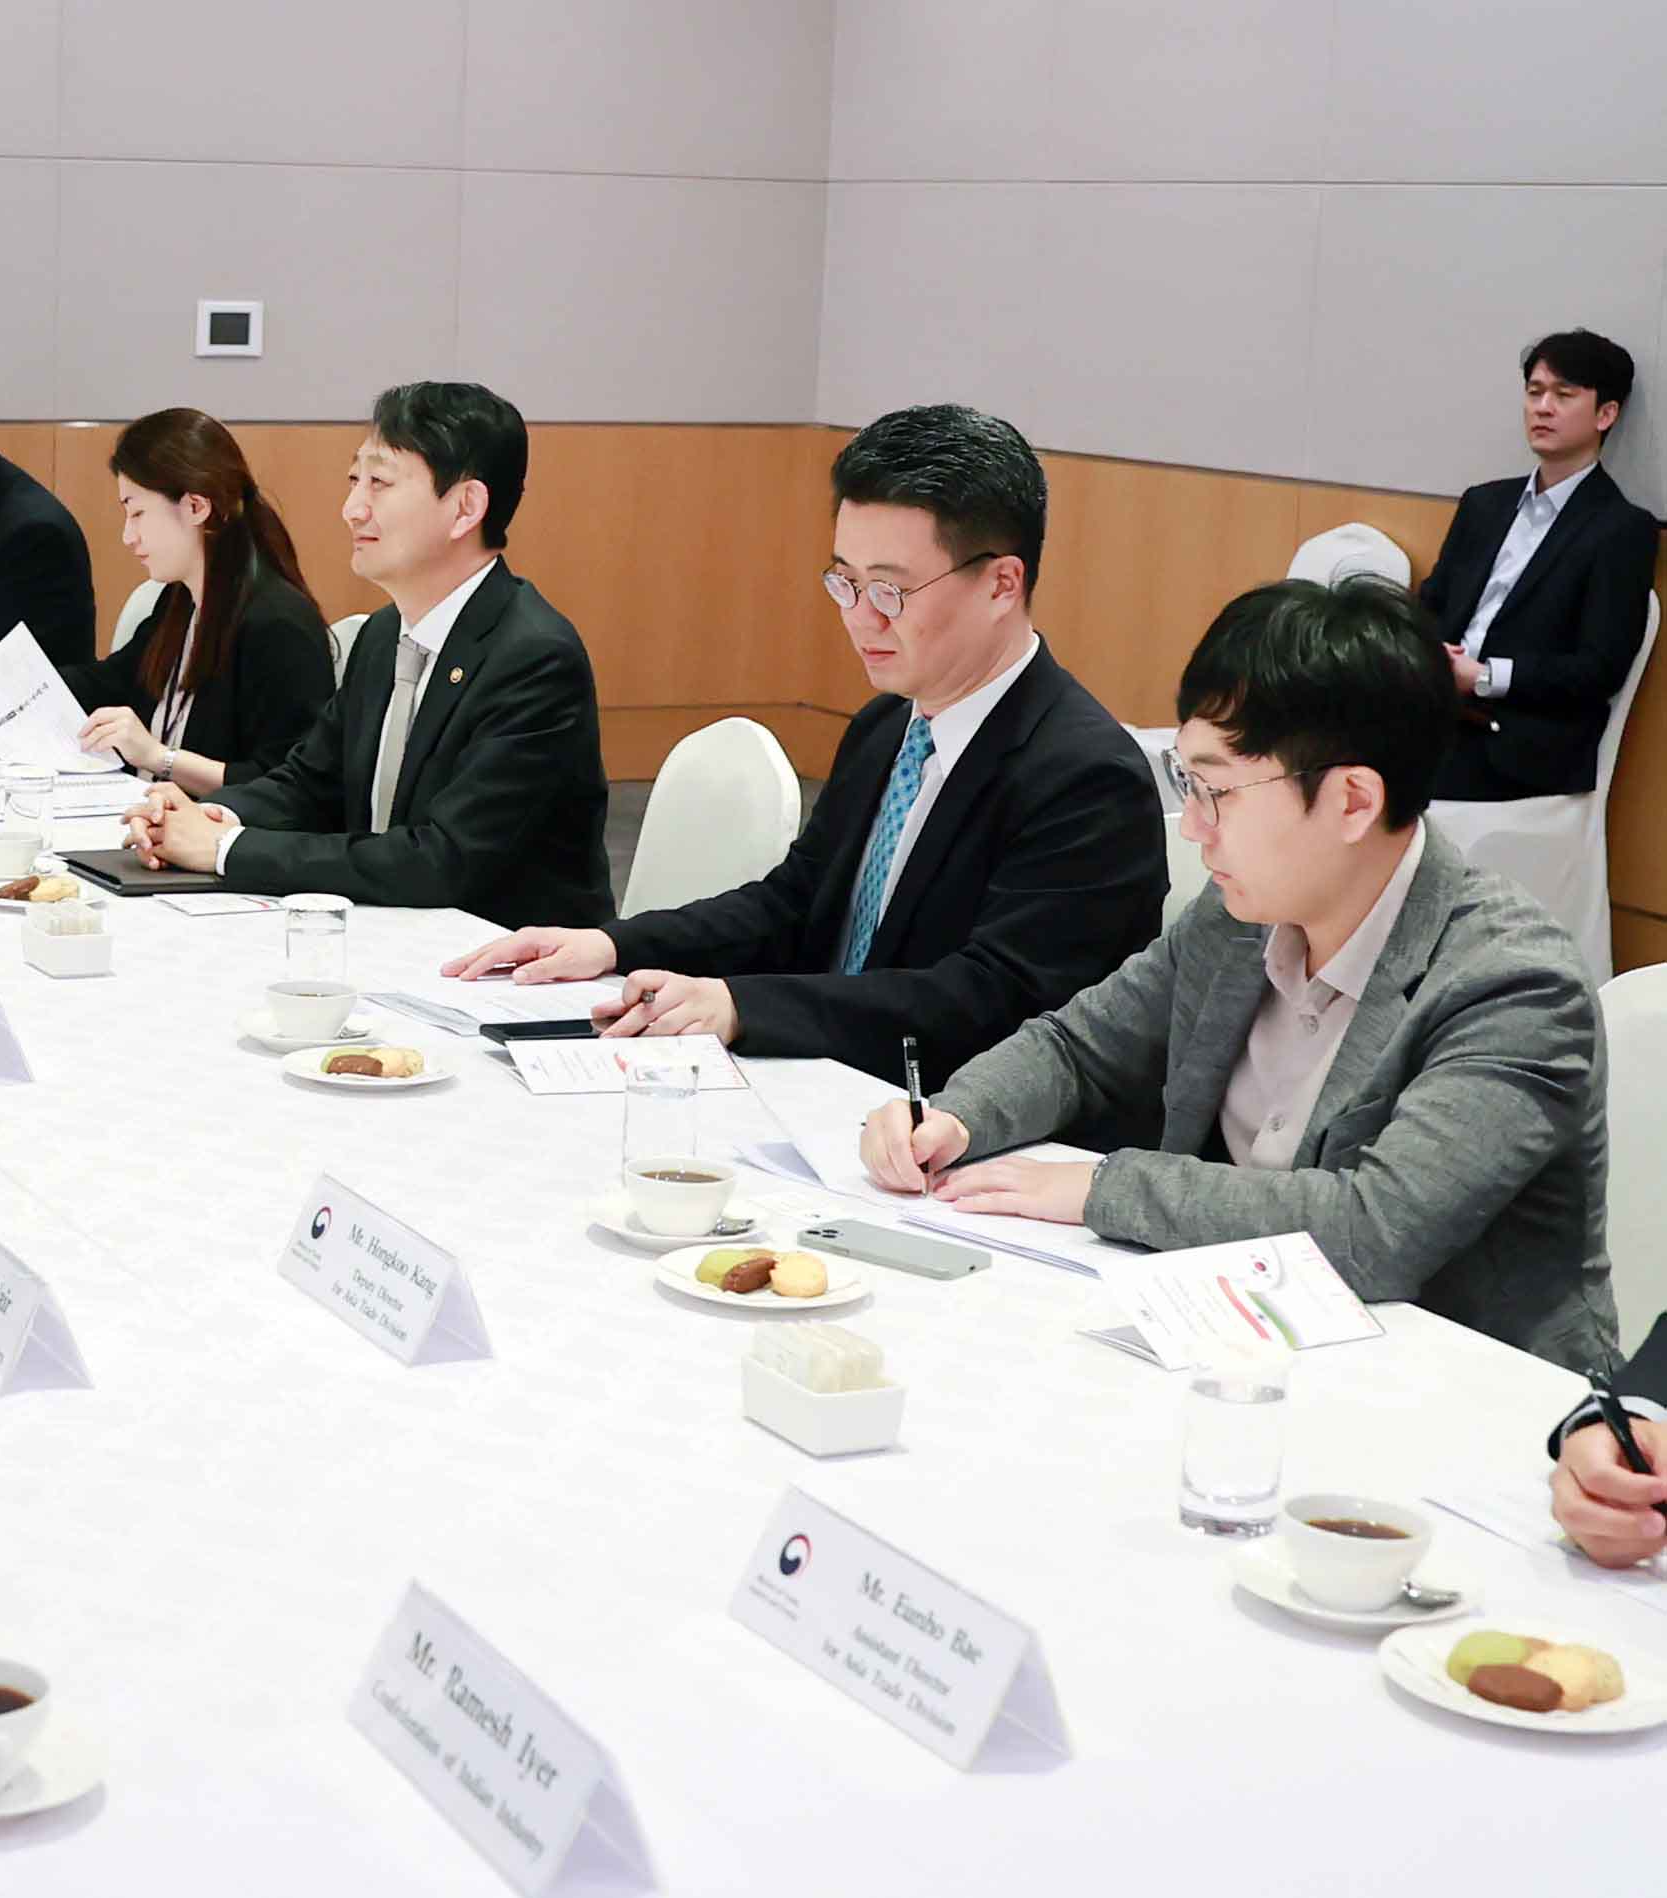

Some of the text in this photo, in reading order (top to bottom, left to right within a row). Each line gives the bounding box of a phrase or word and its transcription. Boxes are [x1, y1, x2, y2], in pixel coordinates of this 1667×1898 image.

[349, 1224, 438, 1300] Mr. Hongkoo Kang
[859, 1571, 984, 1665] Mr. Eunho Bae
[407, 1630, 560, 1790] Mr. Ramesh Iyer
